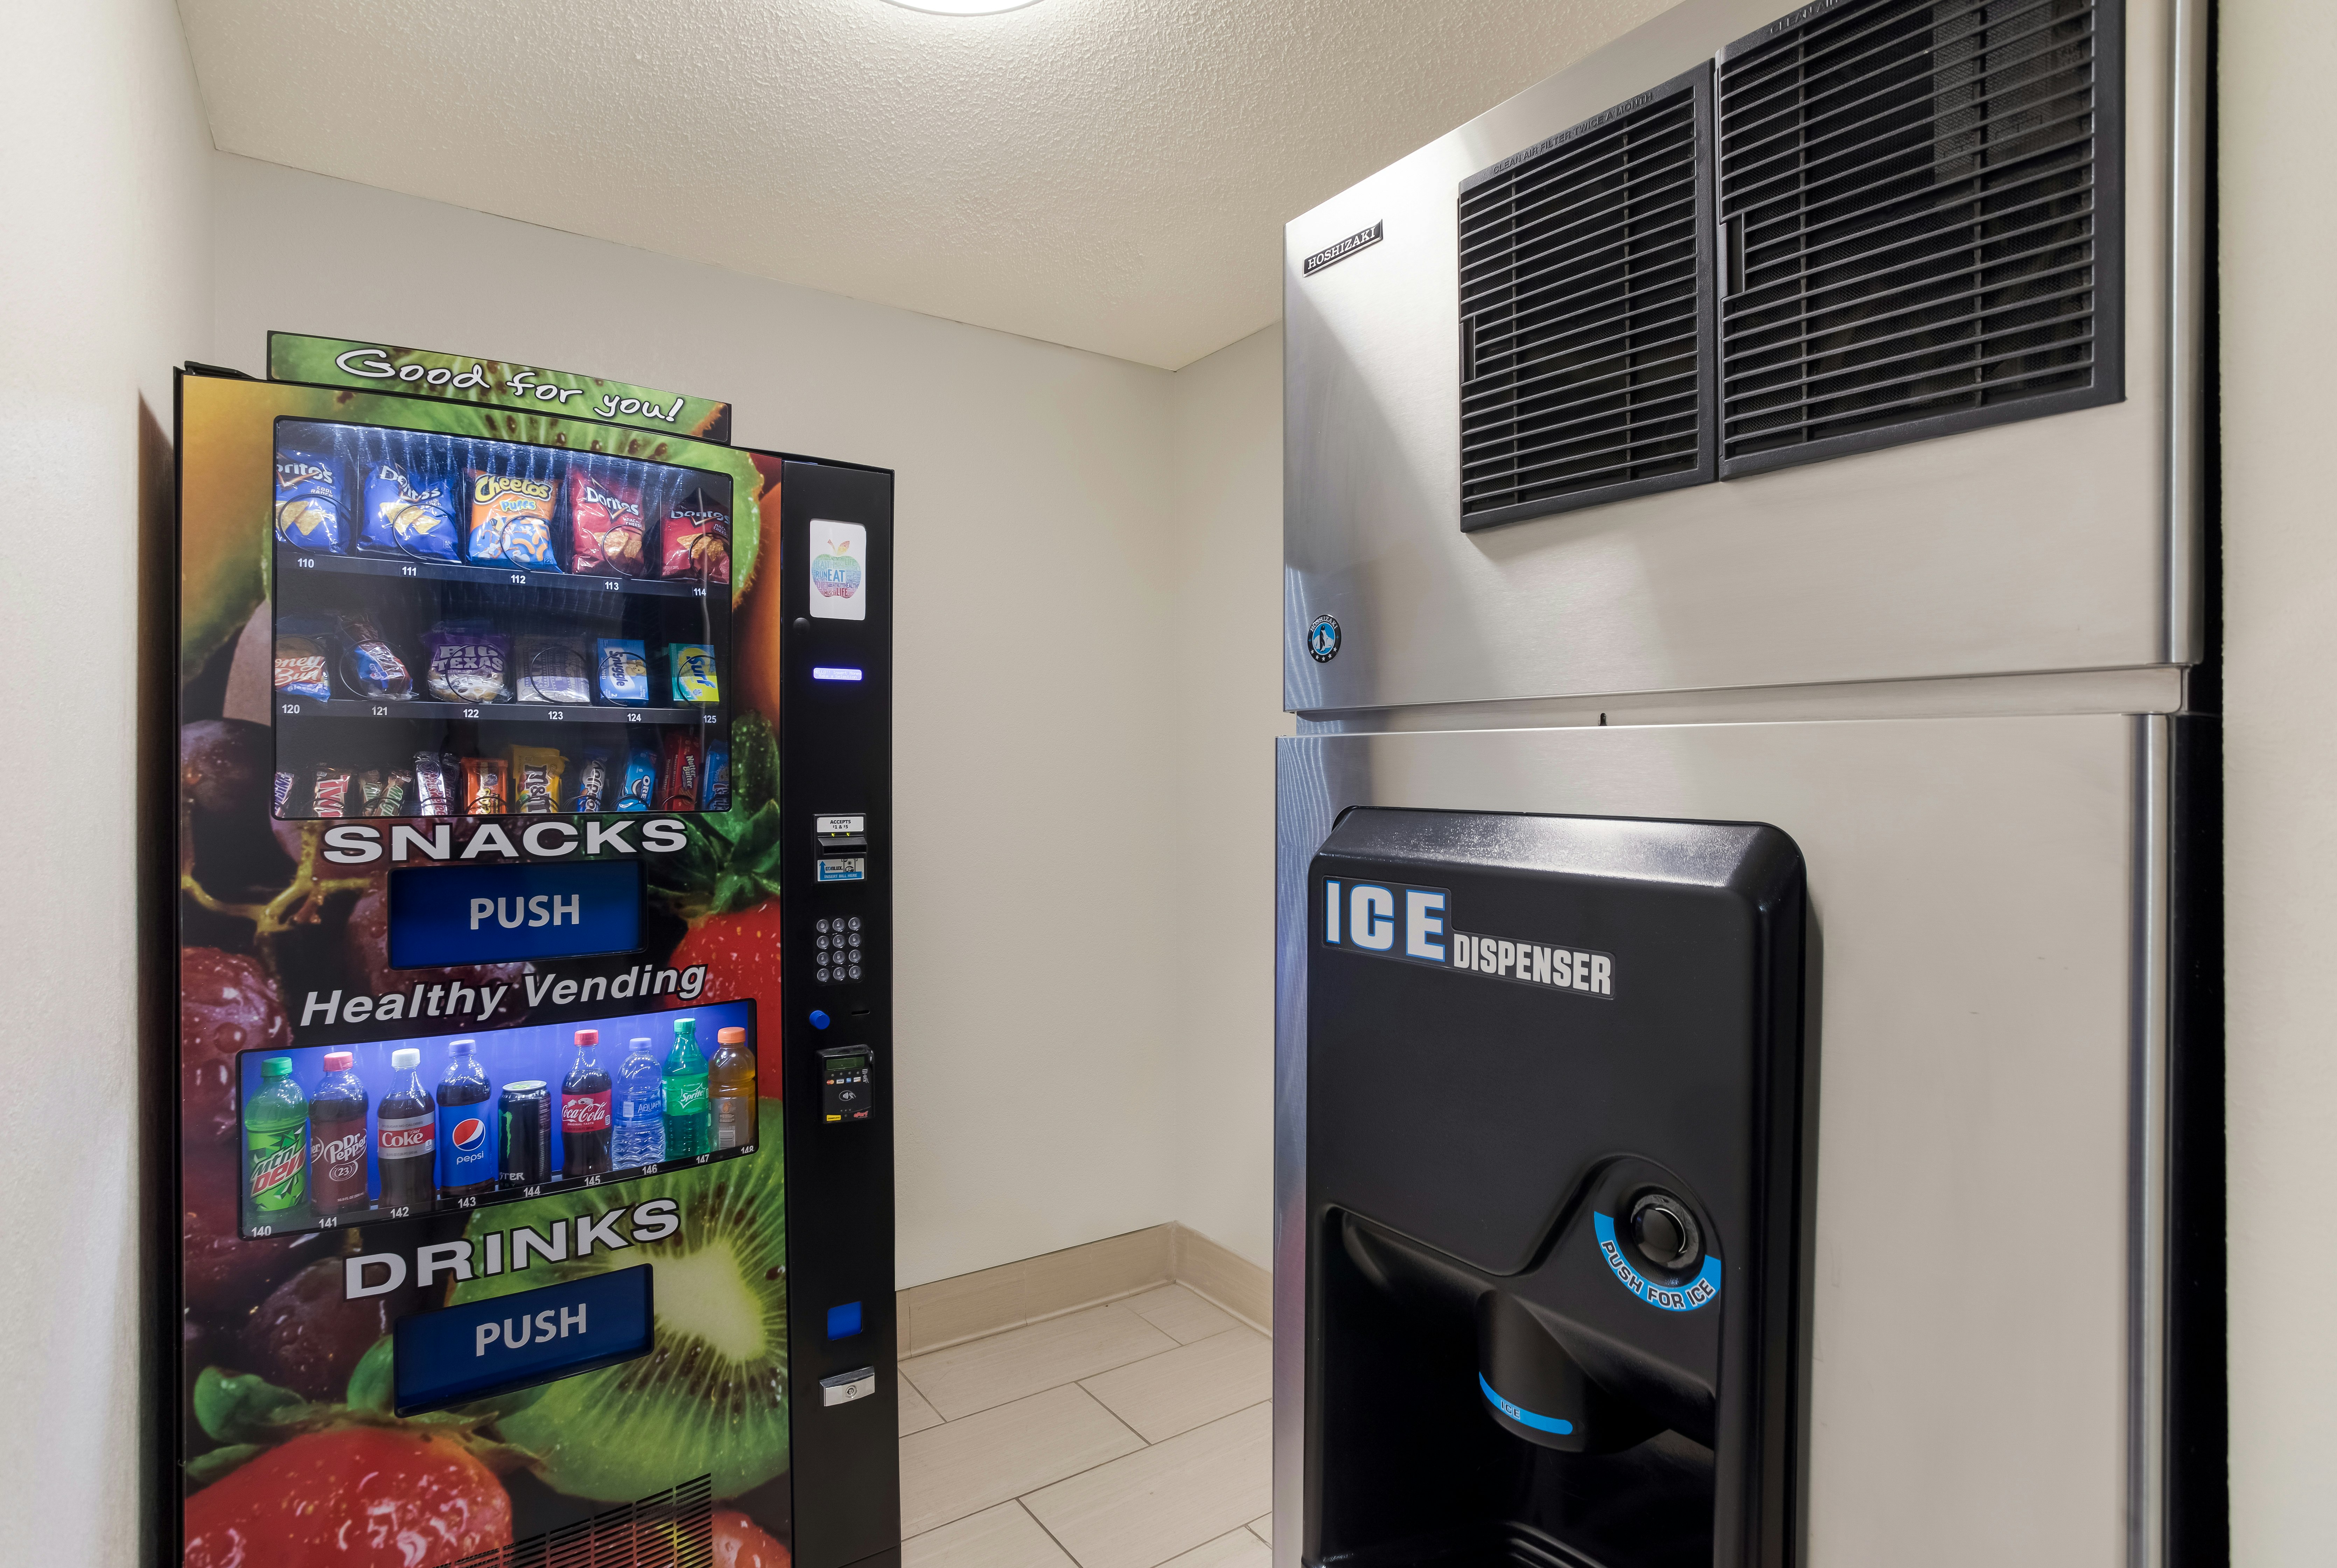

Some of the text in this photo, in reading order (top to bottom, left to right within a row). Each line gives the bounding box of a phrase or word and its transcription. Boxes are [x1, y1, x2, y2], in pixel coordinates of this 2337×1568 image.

[1493, 93, 1652, 174] CLEAN AIR FILTER TWICE A MONTH
[1308, 227, 1376, 270] HOSHIZAKI
[335, 349, 684, 422] Good for you!
[276, 464, 333, 484] oritos
[317, 485, 333, 494] COOL
[380, 465, 442, 500] Doritos
[474, 475, 552, 504] Cheetos
[499, 499, 536, 512] Puffs
[586, 487, 639, 515] Doritos
[671, 509, 729, 525] Doritos
[298, 558, 314, 568] 110
[845, 558, 855, 566] LIFE
[402, 566, 417, 576] 111
[828, 569, 845, 582] EAT
[511, 574, 526, 584] 112
[605, 581, 619, 591] 113
[694, 588, 706, 596] 114
[837, 588, 848, 597] LIFE
[1310, 616, 1338, 632] HOSHIZAKI
[440, 645, 499, 659] BIG
[275, 656, 322, 671] oney
[432, 657, 503, 672] TEXAS
[609, 651, 628, 687] Snuggle
[275, 667, 321, 686] Bun
[686, 656, 716, 689] Surf
[282, 704, 300, 714] 120
[372, 706, 387, 716] 121
[463, 709, 479, 718] 122
[548, 711, 563, 720] 123
[627, 713, 641, 722] 124
[703, 715, 716, 723] 125
[686, 755, 696, 778] Nutter
[683, 766, 694, 788] Butter
[641, 774, 651, 800] ORE
[324, 819, 688, 863] SNACKS
[470, 894, 580, 930] PUSH
[1327, 880, 1445, 962] ICE
[1453, 933, 1611, 995] DISPENSER
[301, 964, 707, 1026] Healthy Vending
[680, 1090, 704, 1102] Sprite
[562, 1101, 607, 1123] Coca-Cola
[342, 1133, 361, 1149] Dr
[382, 1132, 424, 1147] Coke
[324, 1135, 367, 1164] Pepper
[741, 1145, 754, 1154] 148
[456, 1151, 484, 1165] pepsi
[696, 1154, 710, 1164] 147
[337, 1167, 350, 1177] 23
[499, 1172, 525, 1181] STER
[642, 1164, 658, 1175] 146
[584, 1175, 601, 1187] 145
[524, 1186, 540, 1197] 144
[457, 1197, 476, 1208] 143
[390, 1207, 409, 1219] 142
[319, 1217, 337, 1228] 141
[251, 1225, 272, 1237] 140
[347, 1200, 678, 1300] DRINKS
[1601, 1240, 1716, 1309] PUSH FOR ICE
[476, 1303, 587, 1357] PUSH
[1500, 1400, 1520, 1420] ICE
